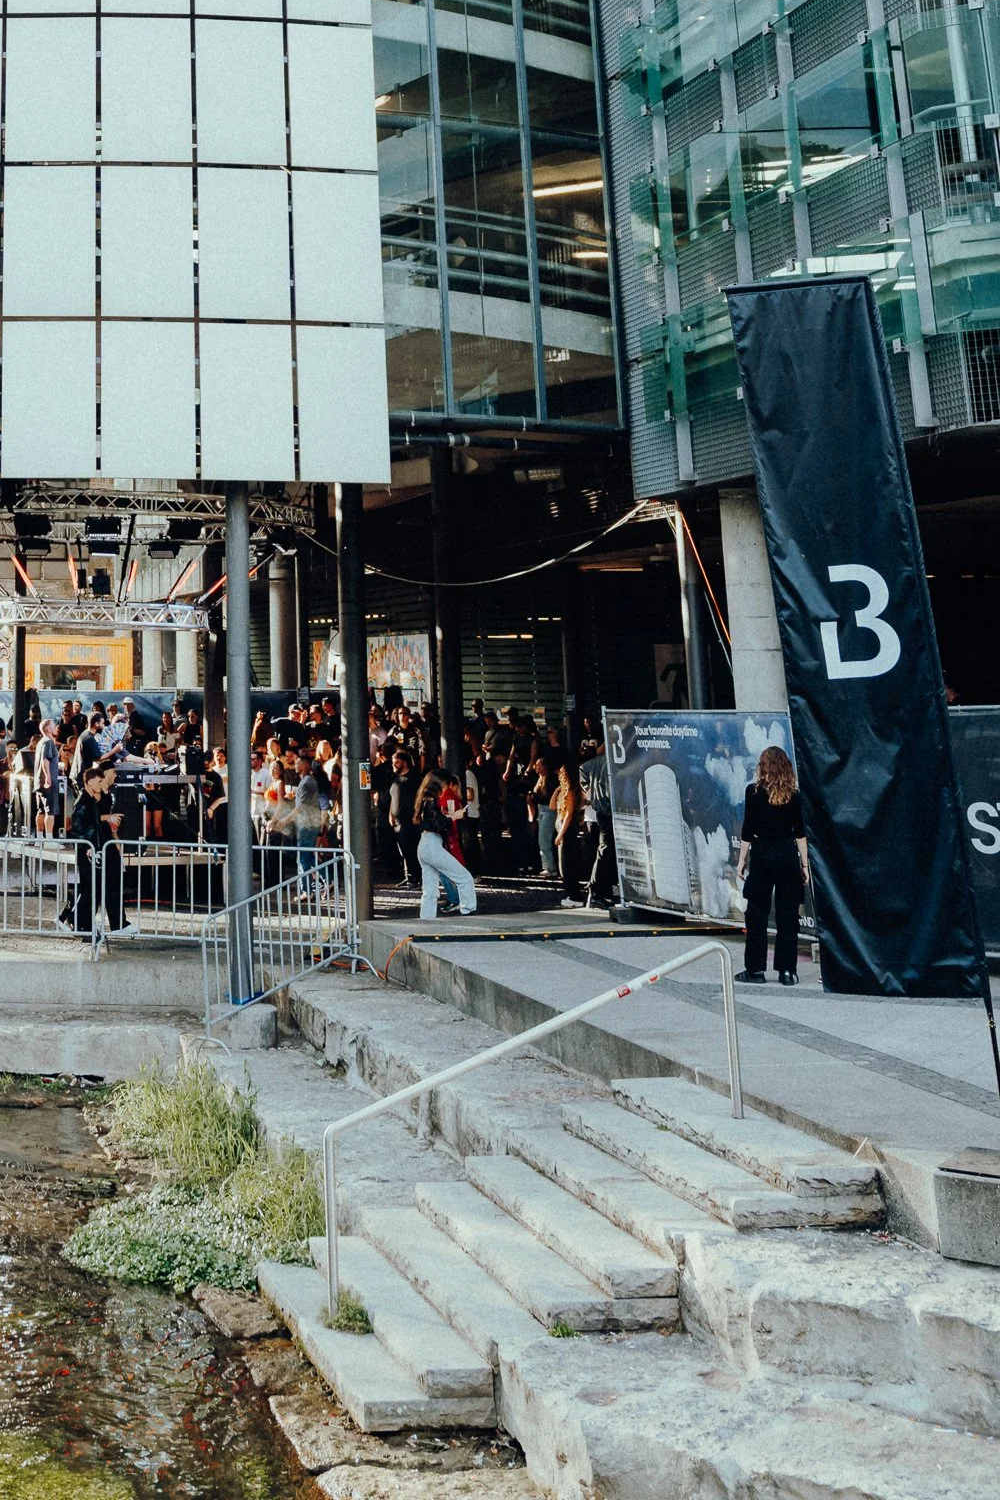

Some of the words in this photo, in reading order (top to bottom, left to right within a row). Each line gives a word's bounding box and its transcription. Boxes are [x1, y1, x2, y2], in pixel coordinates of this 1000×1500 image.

[634, 725, 649, 736] Your
[648, 724, 673, 736] favorite
[673, 725, 698, 740] daytime
[636, 737, 671, 751] experience.
